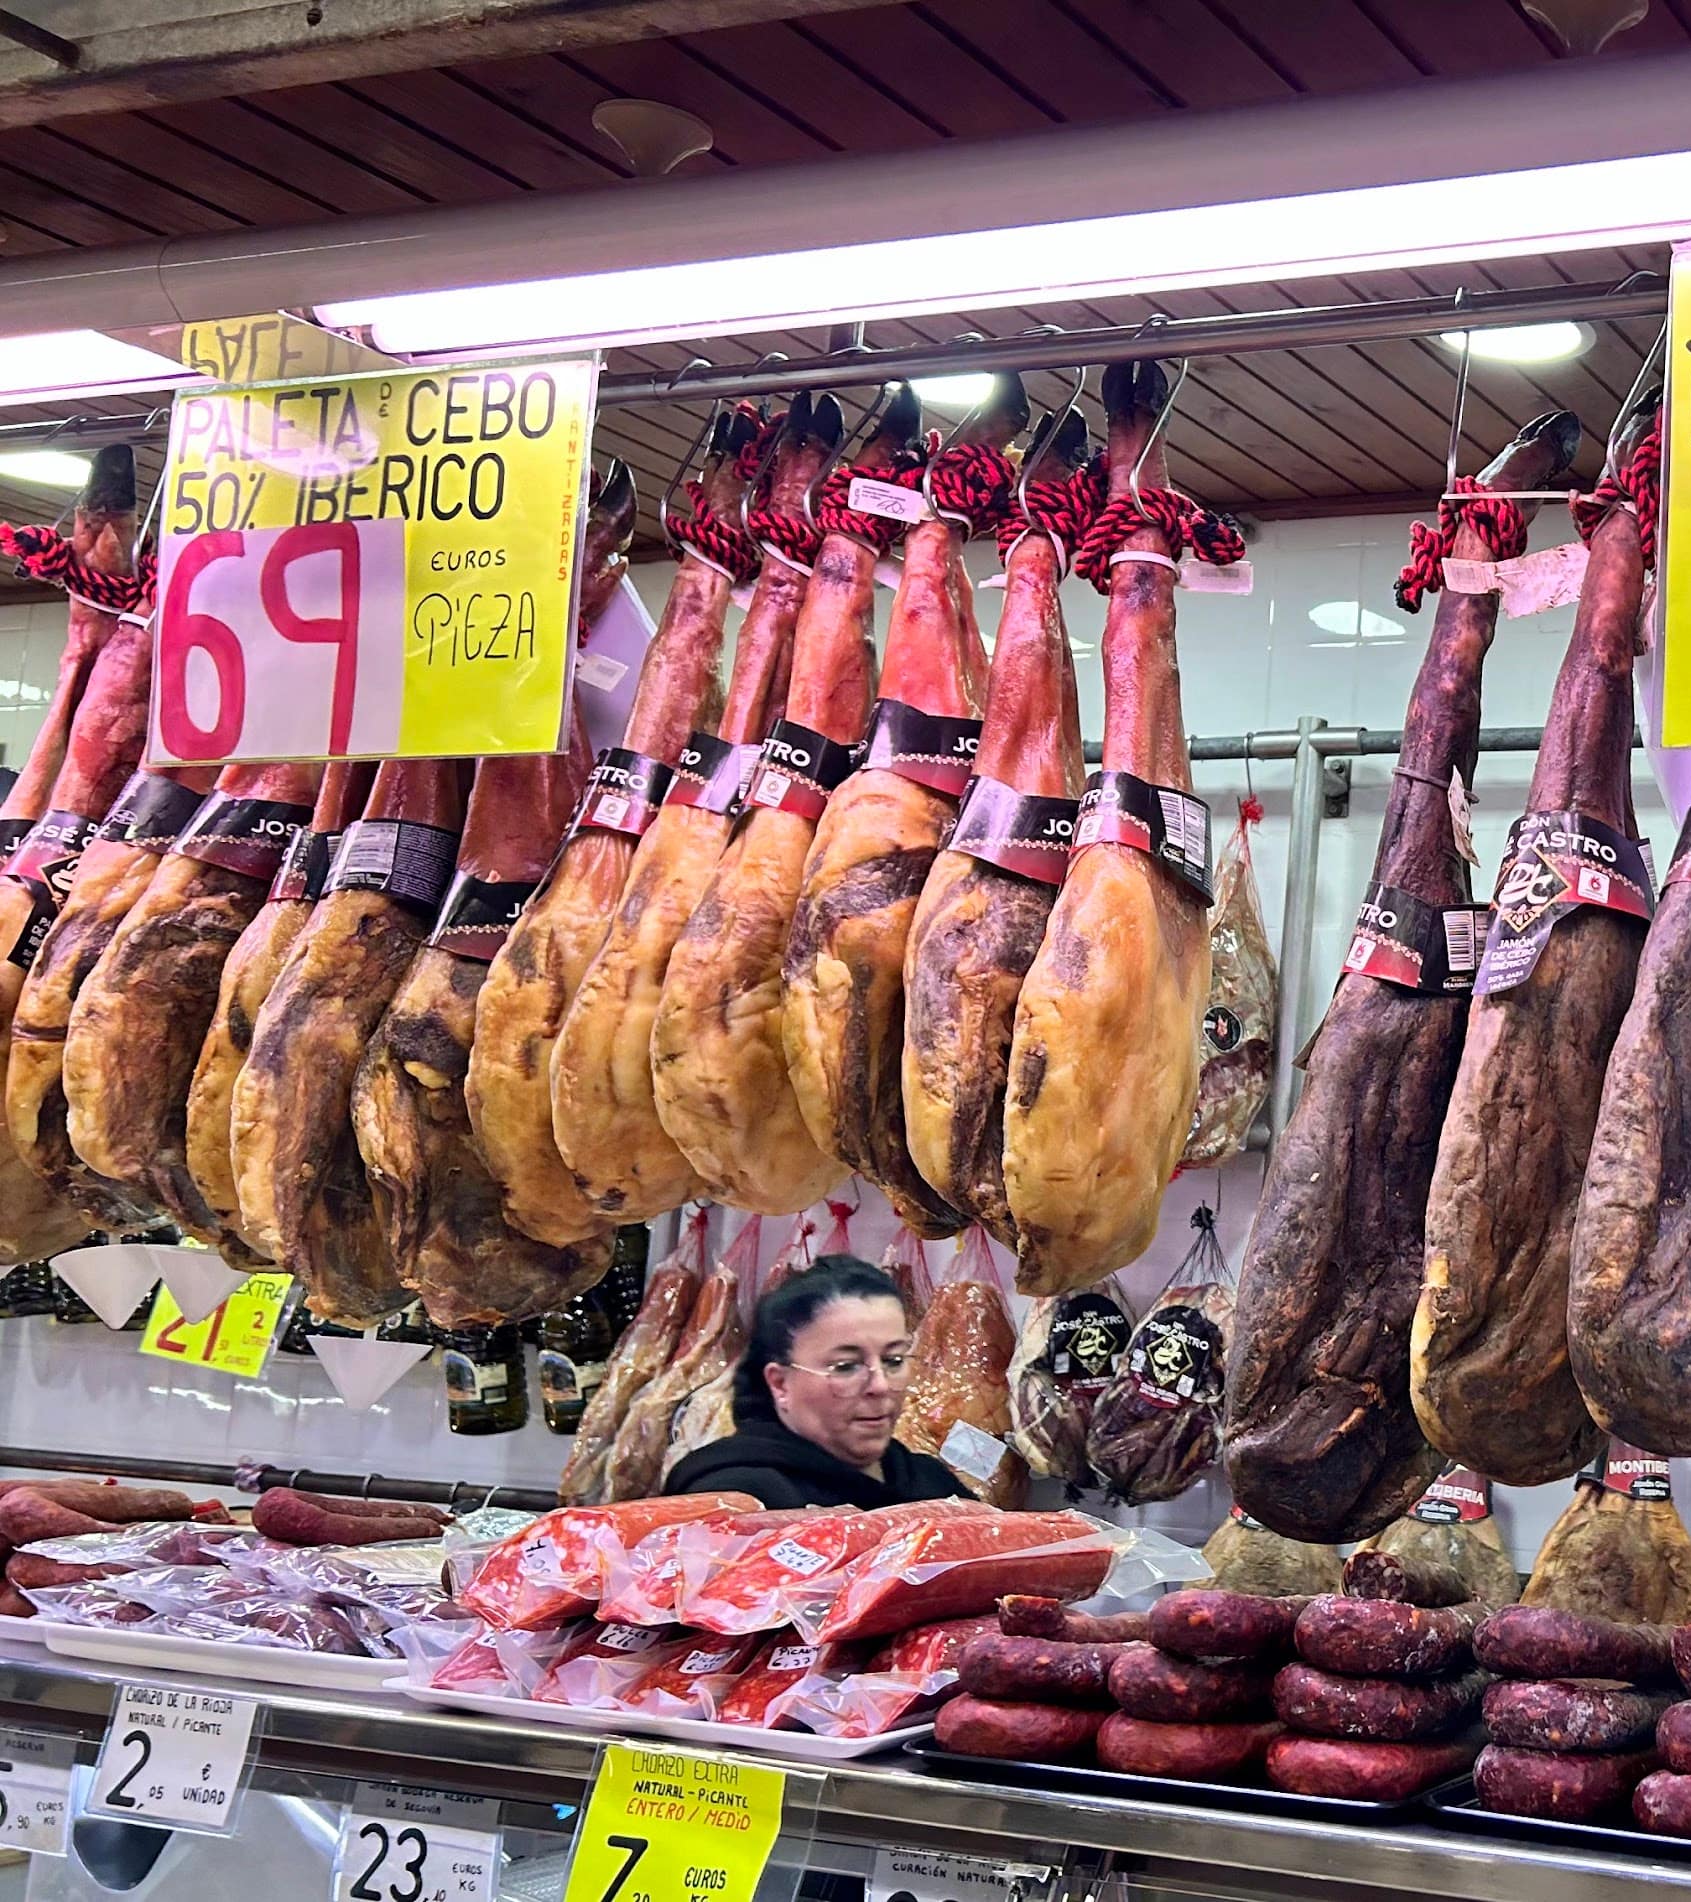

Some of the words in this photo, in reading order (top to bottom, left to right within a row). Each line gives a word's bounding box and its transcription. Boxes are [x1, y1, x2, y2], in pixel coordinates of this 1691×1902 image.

[178, 387, 361, 464] PALETA
[406, 371, 556, 446] CEBO
[557, 400, 581, 581] ANTIZADAS
[173, 471, 266, 534] 50%
[431, 550, 506, 571] EUROS
[160, 521, 360, 760] 69
[761, 738, 811, 767] STRO
[953, 736, 979, 753] JO
[588, 765, 648, 791] STRO
[1079, 789, 1120, 812] TRO
[251, 818, 298, 837] JOS
[1519, 816, 1551, 832] DON
[1516, 831, 1617, 863] CASTRO
[1359, 902, 1398, 929] TRO
[1497, 936, 1537, 950] JAMÓN
[1491, 951, 1507, 961] DE
[1507, 947, 1537, 959] CEBO
[1608, 1460, 1669, 1474] MONTIBE
[167, 1693, 180, 1708] DE
[185, 1696, 196, 1710] LA
[128, 1711, 166, 1728] NATURAL
[202, 1763, 211, 1781] €
[693, 1760, 739, 1785] EXTRA
[633, 1780, 685, 1799] NATURAL
[626, 1797, 685, 1821] ENTERO
[452, 1863, 482, 1875] EUROS
[684, 1866, 727, 1890] EUROS
[459, 1880, 476, 1892] KG
